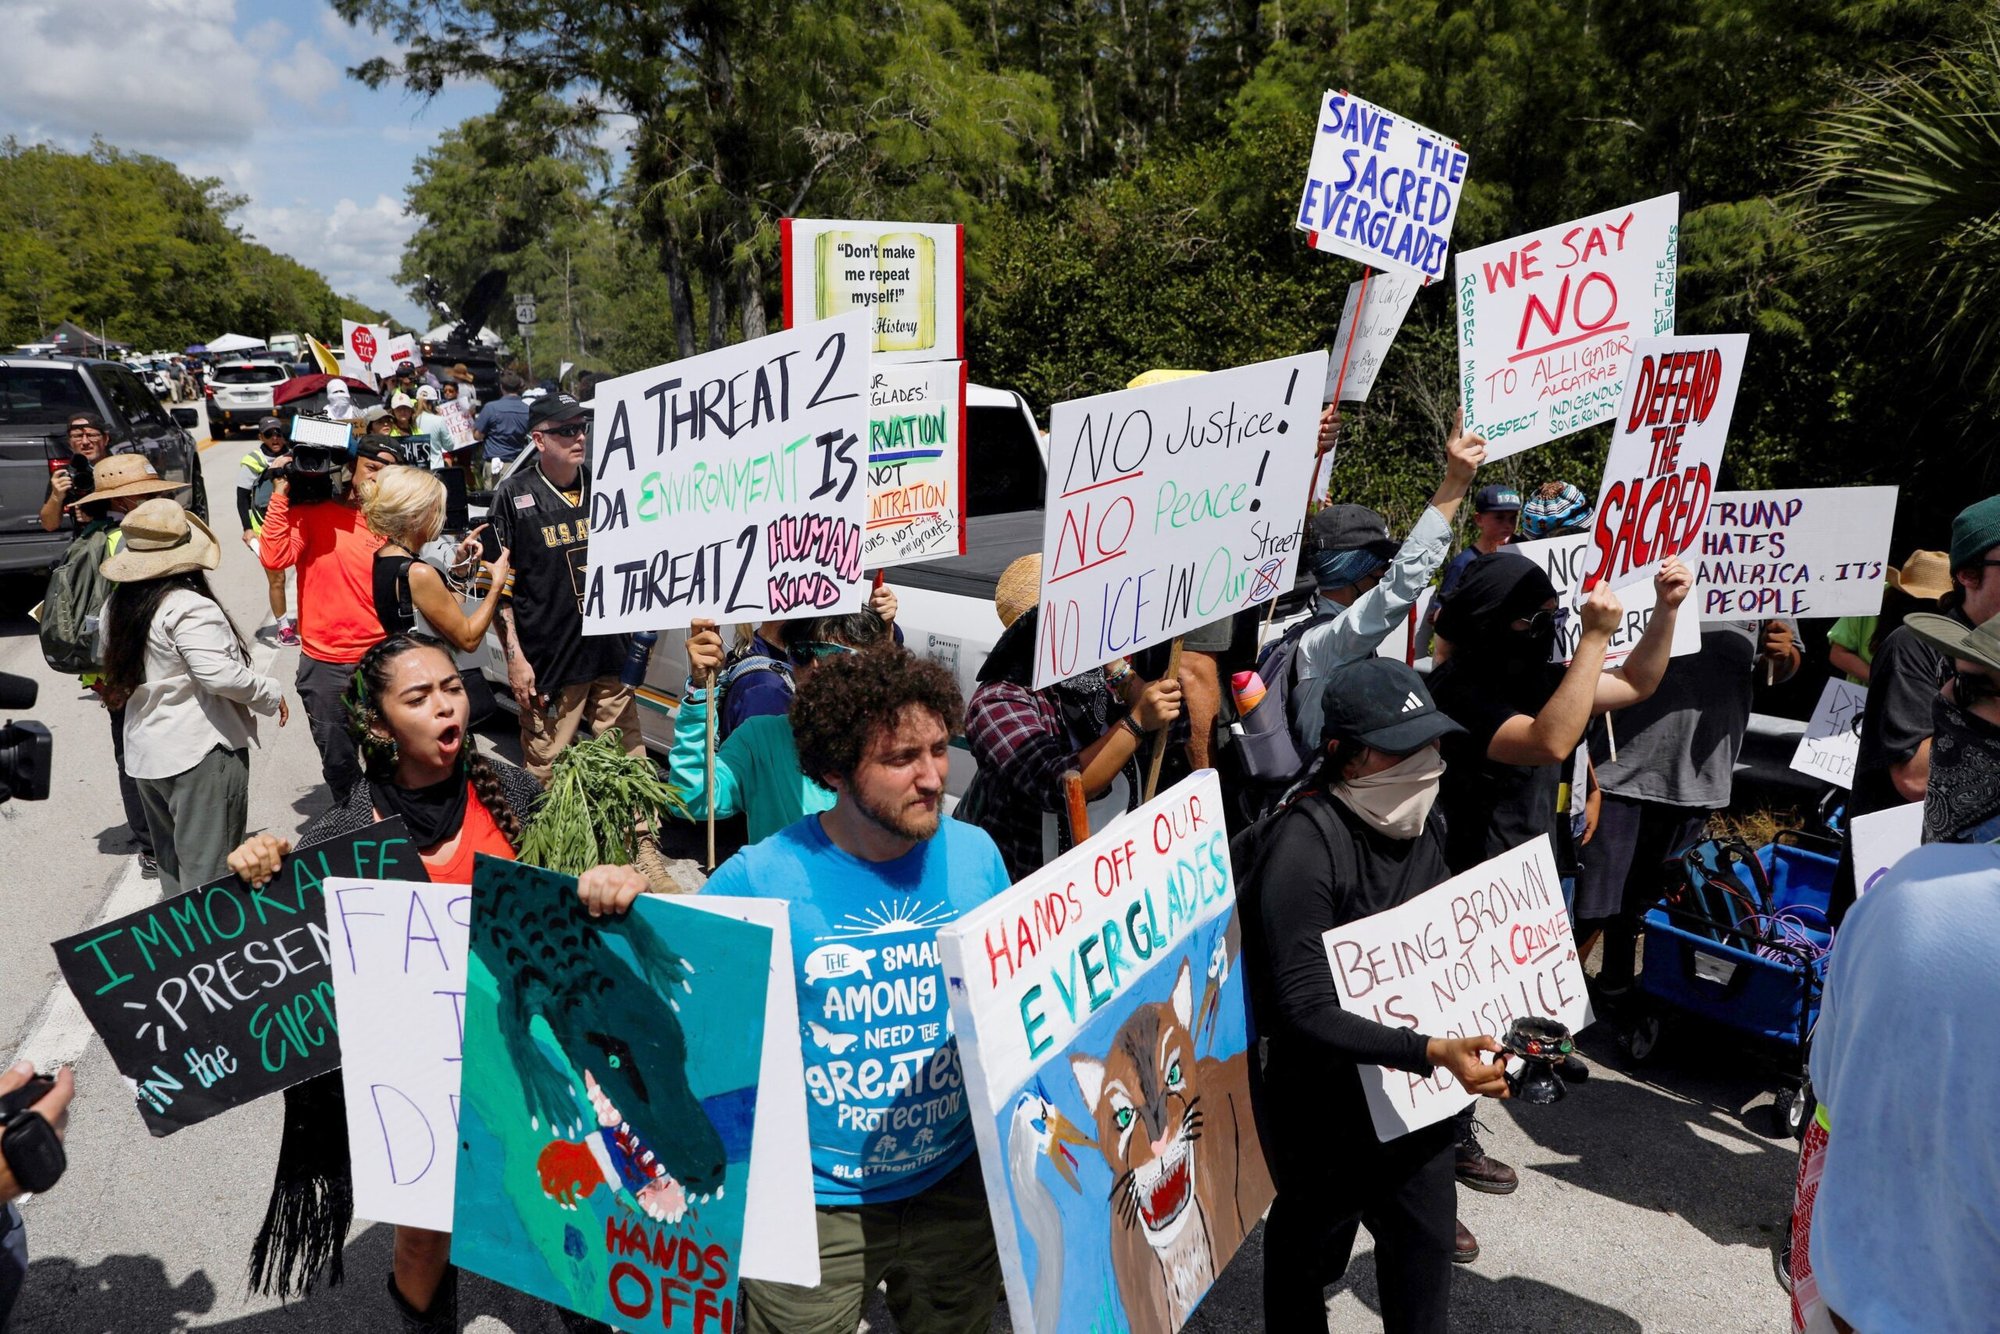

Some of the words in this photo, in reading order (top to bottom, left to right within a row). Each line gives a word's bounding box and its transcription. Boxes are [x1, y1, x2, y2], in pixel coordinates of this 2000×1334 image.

[1323, 97, 1393, 152] SAVE
[1417, 137, 1467, 183] THE
[1334, 149, 1451, 226] SACRED
[882, 245, 915, 259] make
[1299, 179, 1448, 275] EVERGLADES
[1482, 239, 1545, 296] WE
[1555, 211, 1635, 269] SAY
[845, 270, 865, 281] me
[870, 268, 910, 284] repeat
[1460, 273, 1477, 348] RESPECT
[1516, 271, 1619, 350] NO
[1654, 259, 1666, 298] THE
[1663, 224, 1679, 331] EVERGLADES
[519, 308, 533, 319] 41
[359, 345, 373, 358] ICE
[1485, 368, 1517, 404] TO
[1531, 334, 1634, 388] ALLIGATOR
[1537, 363, 1618, 402] ALCATRAZ
[597, 400, 636, 480] A
[644, 350, 800, 456] THREAT
[806, 332, 860, 410] 2
[870, 381, 928, 406] GLADES!
[1463, 359, 1475, 429] MIGRANTS
[1474, 410, 1539, 441] RESPECT
[1549, 380, 1623, 418] INDIGENOUS
[1625, 346, 1723, 436] DEFEND
[590, 487, 629, 534] DA
[636, 434, 812, 522] ENVIRONMENT
[809, 428, 860, 503] IS
[867, 461, 908, 488] NOT
[1063, 410, 1152, 493] NO
[1647, 424, 1685, 480] THE
[872, 480, 947, 520] NTRATION
[891, 522, 914, 546] NOT
[1583, 462, 1712, 593] SACRED
[1706, 498, 1803, 529] TRUMP
[585, 564, 606, 619] A
[614, 538, 735, 616] THREAT
[724, 524, 763, 614] 2
[767, 512, 864, 584] HUMAN
[1052, 495, 1135, 577] NO
[1243, 518, 1303, 562] Street
[1702, 531, 1786, 559] HATES
[767, 571, 841, 615] KIND
[1695, 560, 1810, 586] AMERICA
[1835, 561, 1882, 582] IT'S
[1705, 588, 1811, 616] PEOPLE
[1034, 599, 1080, 690] NO
[1098, 568, 1156, 660] ICE
[1161, 562, 1195, 632] IN
[1196, 546, 1251, 617] Our
[984, 882, 1083, 989] HANDS
[1094, 839, 1137, 897] OFF
[1153, 795, 1208, 855] OUR
[1332, 923, 1446, 999] BEING
[1450, 853, 1550, 946] BROWN
[821, 953, 851, 974] THE
[1019, 830, 1228, 1060] EVERGLADES
[1431, 942, 1481, 1014] NOT
[1490, 944, 1511, 983] A
[183, 1044, 238, 1088] the
[864, 1025, 915, 1050] NEED
[917, 1022, 940, 1042] THE
[606, 1216, 729, 1289] HANDS
